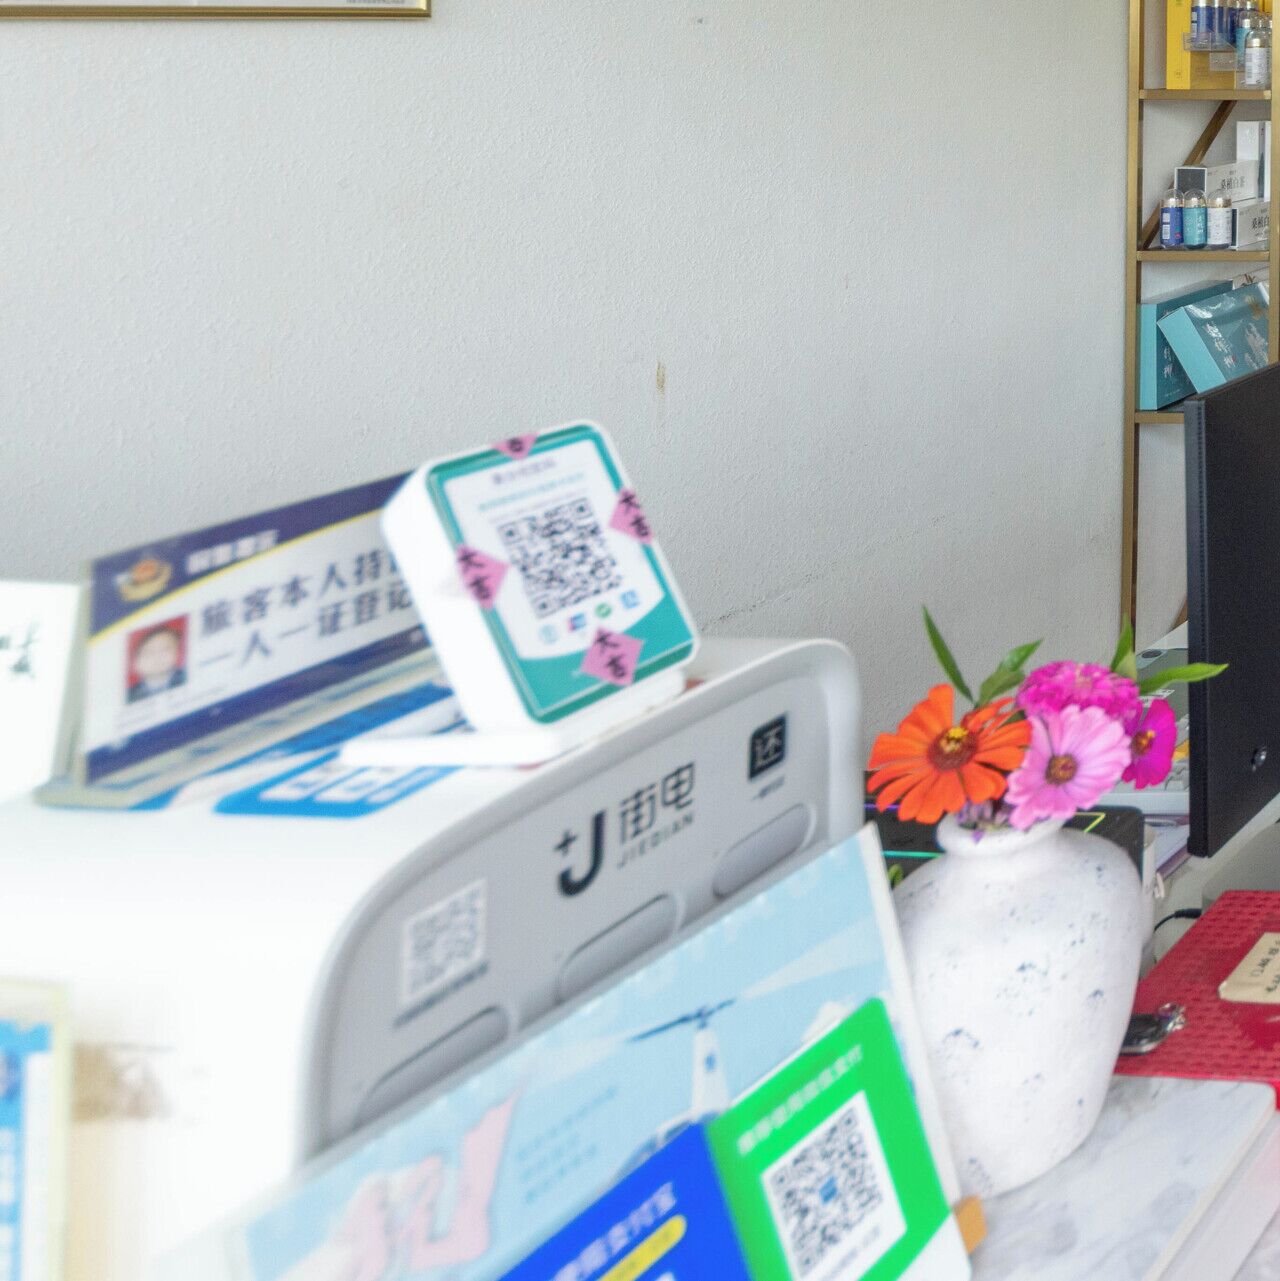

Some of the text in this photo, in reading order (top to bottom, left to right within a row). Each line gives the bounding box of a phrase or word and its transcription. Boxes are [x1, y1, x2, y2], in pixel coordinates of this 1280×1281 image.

[199, 542, 401, 637] 旅客本人持
[754, 724, 784, 768] 还
[619, 761, 696, 845] 街电
[616, 812, 695, 871] JIEDIAN
